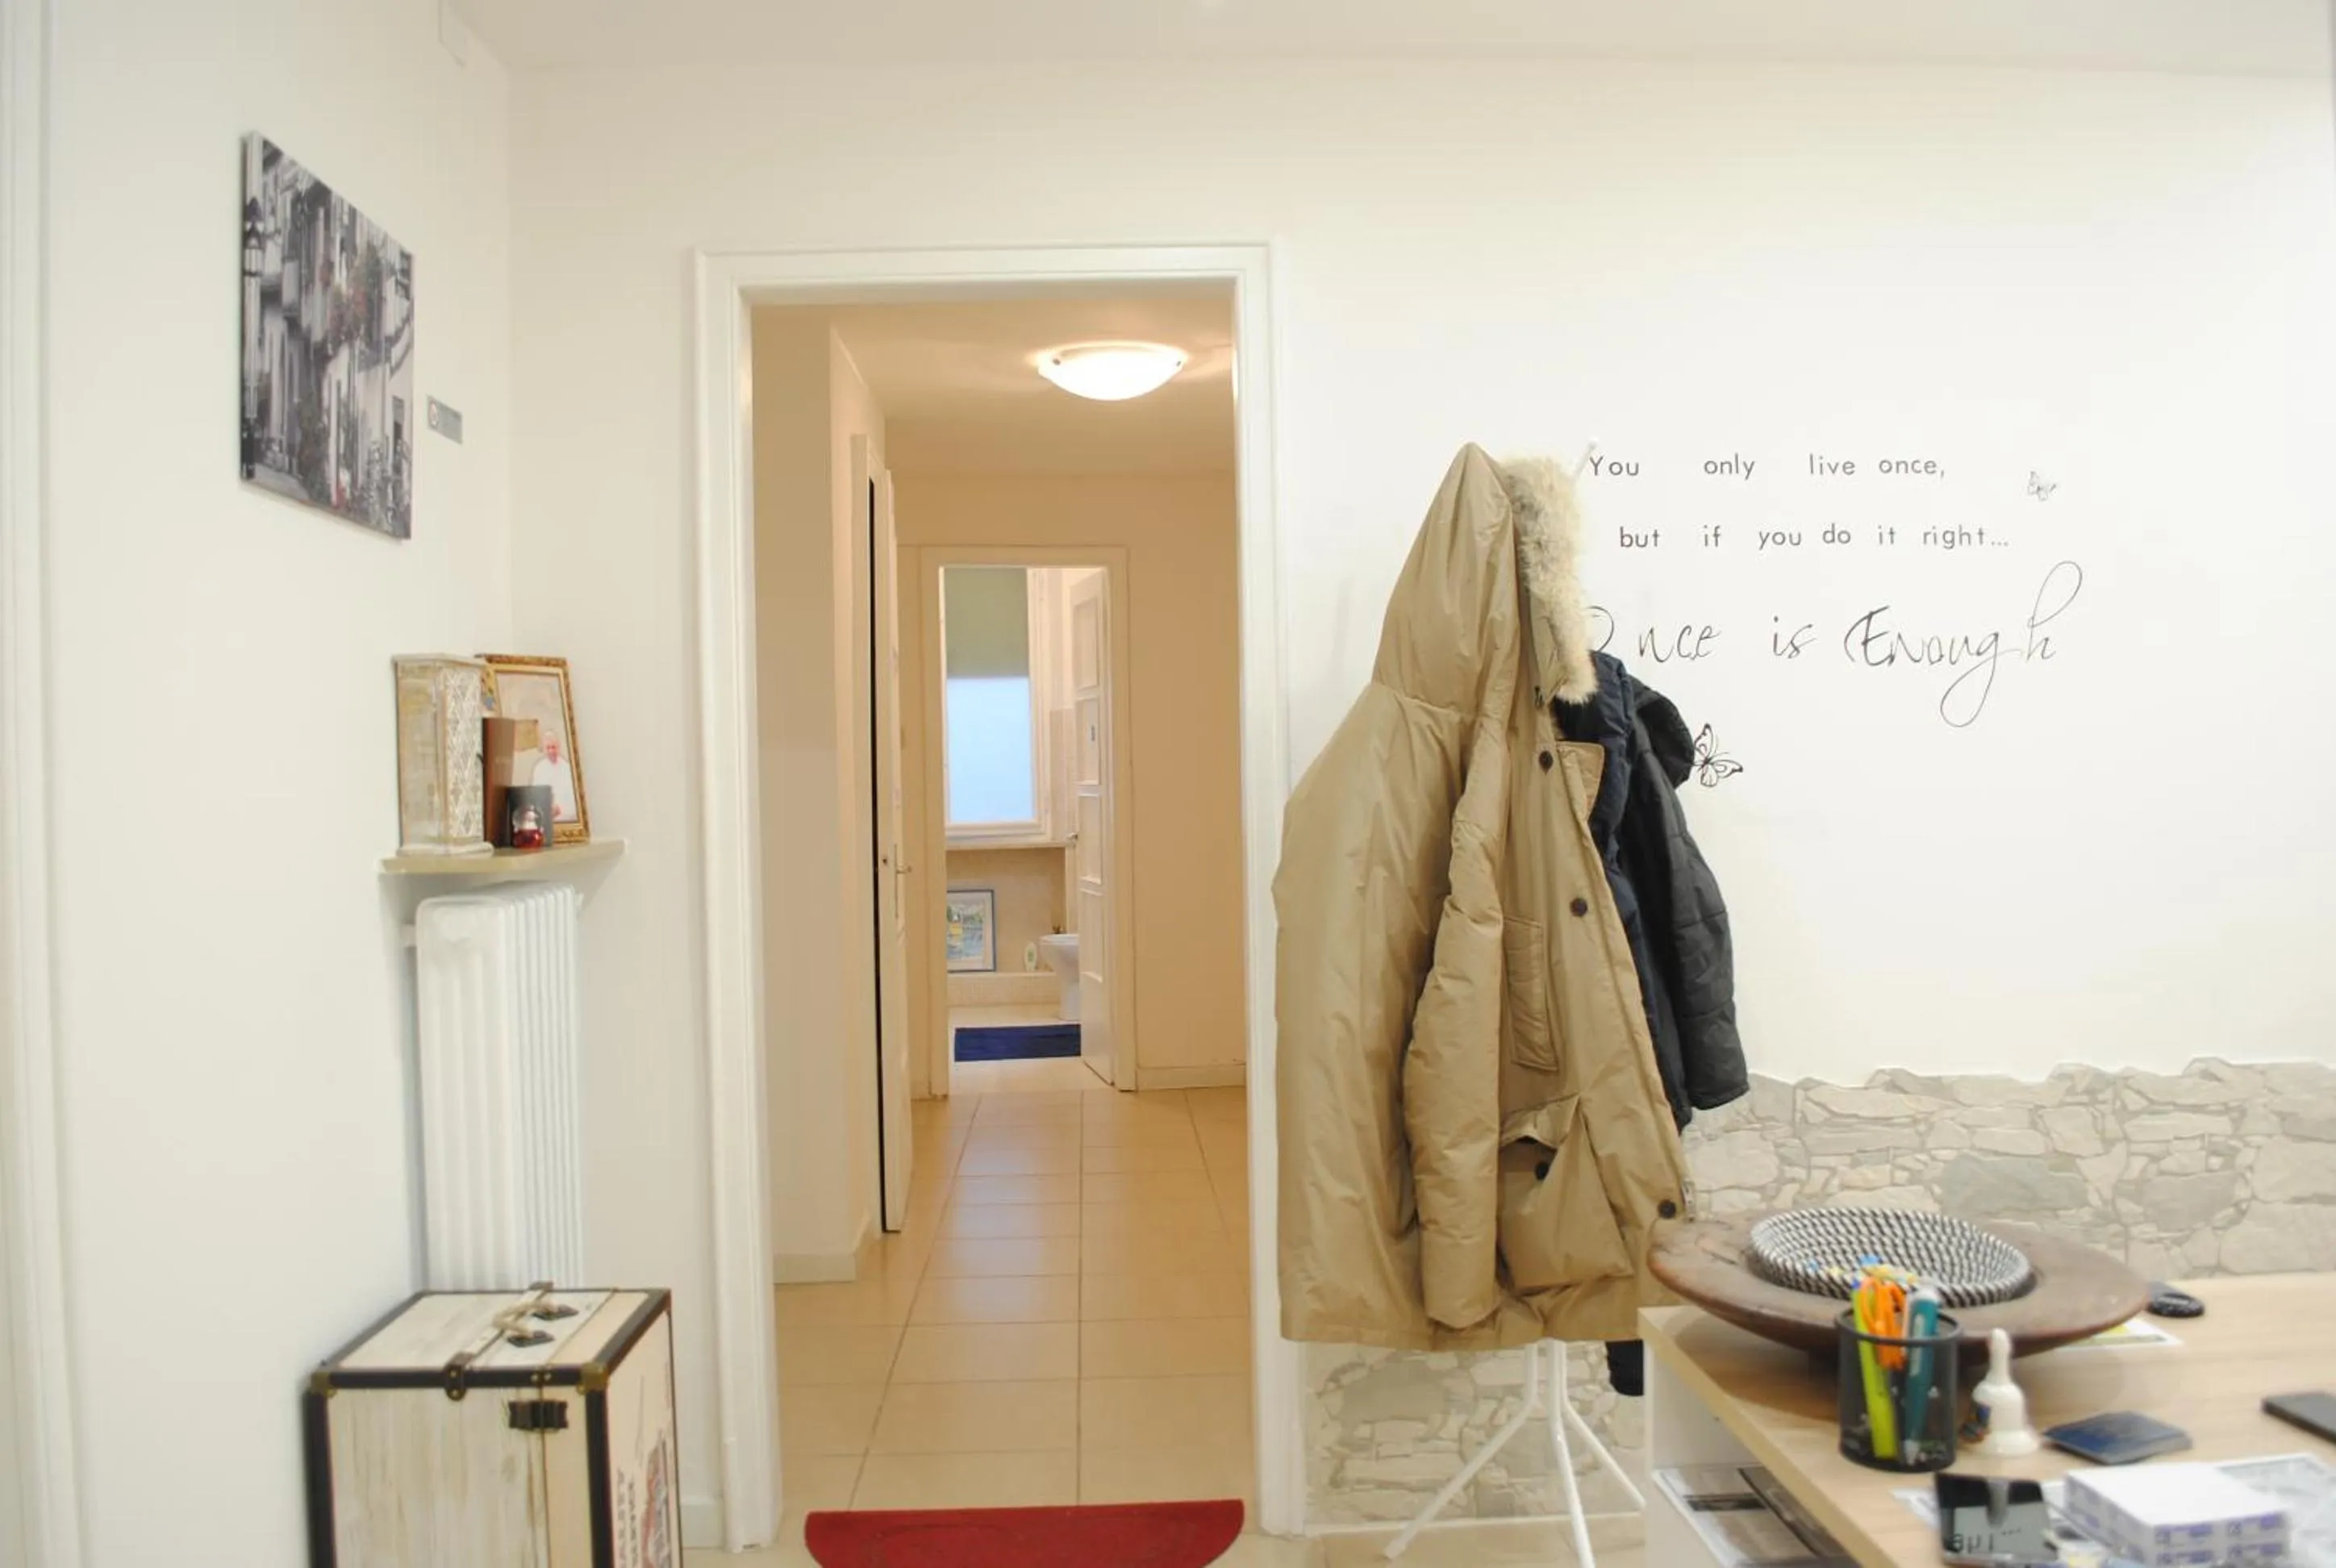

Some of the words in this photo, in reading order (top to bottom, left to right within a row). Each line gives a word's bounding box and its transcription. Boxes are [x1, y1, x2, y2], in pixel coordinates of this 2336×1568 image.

[1589, 455, 1640, 477] You
[1703, 452, 1756, 482] only
[1808, 452, 1856, 476] live
[1878, 457, 1946, 478] once,
[1619, 525, 1661, 549] but
[1703, 524, 1721, 548] if
[1758, 530, 1802, 551] you
[1821, 522, 1852, 545] do
[1877, 524, 1896, 546] it
[1922, 523, 2009, 551] right...
[1772, 615, 1817, 660] is
[1842, 560, 2084, 728] Enough
